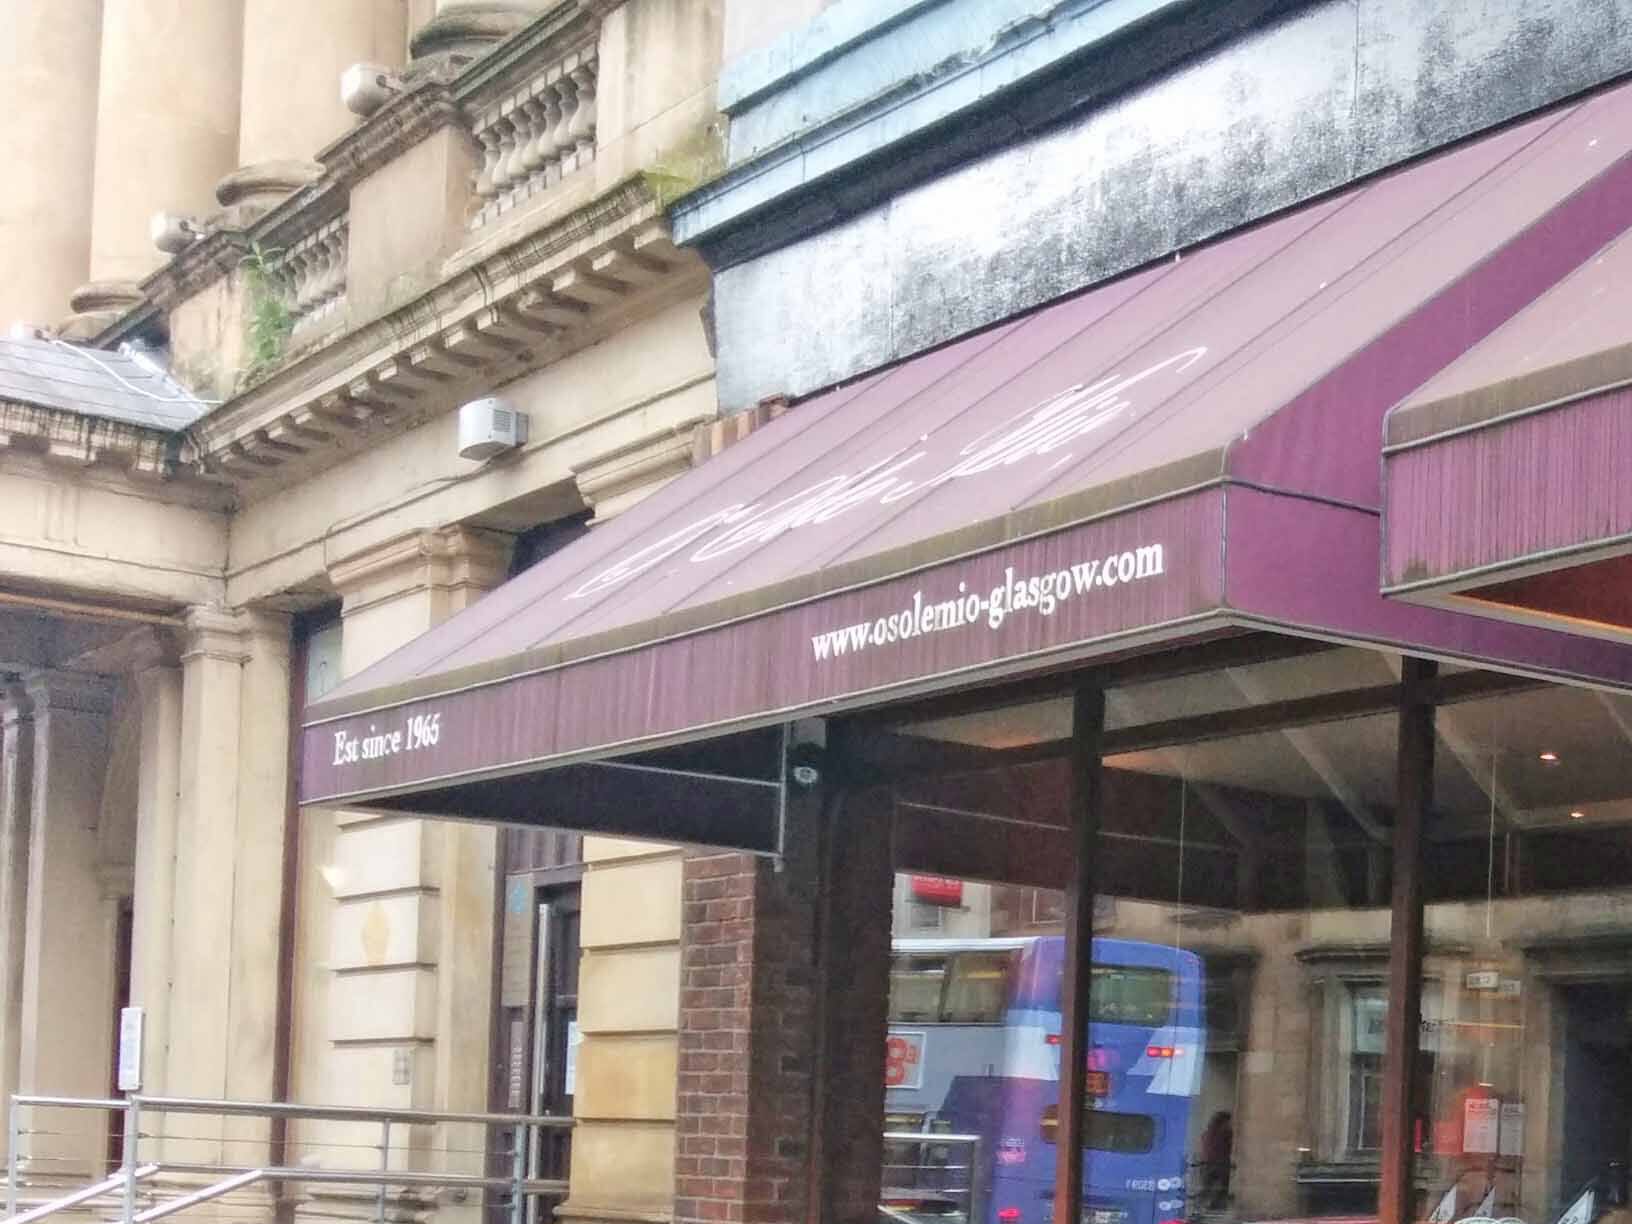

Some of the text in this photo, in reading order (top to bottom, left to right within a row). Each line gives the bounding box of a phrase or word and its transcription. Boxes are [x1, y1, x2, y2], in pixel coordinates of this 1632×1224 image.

[811, 540, 1164, 663] www.osolemio-glasgow.com
[332, 713, 441, 766] Est since 1965
